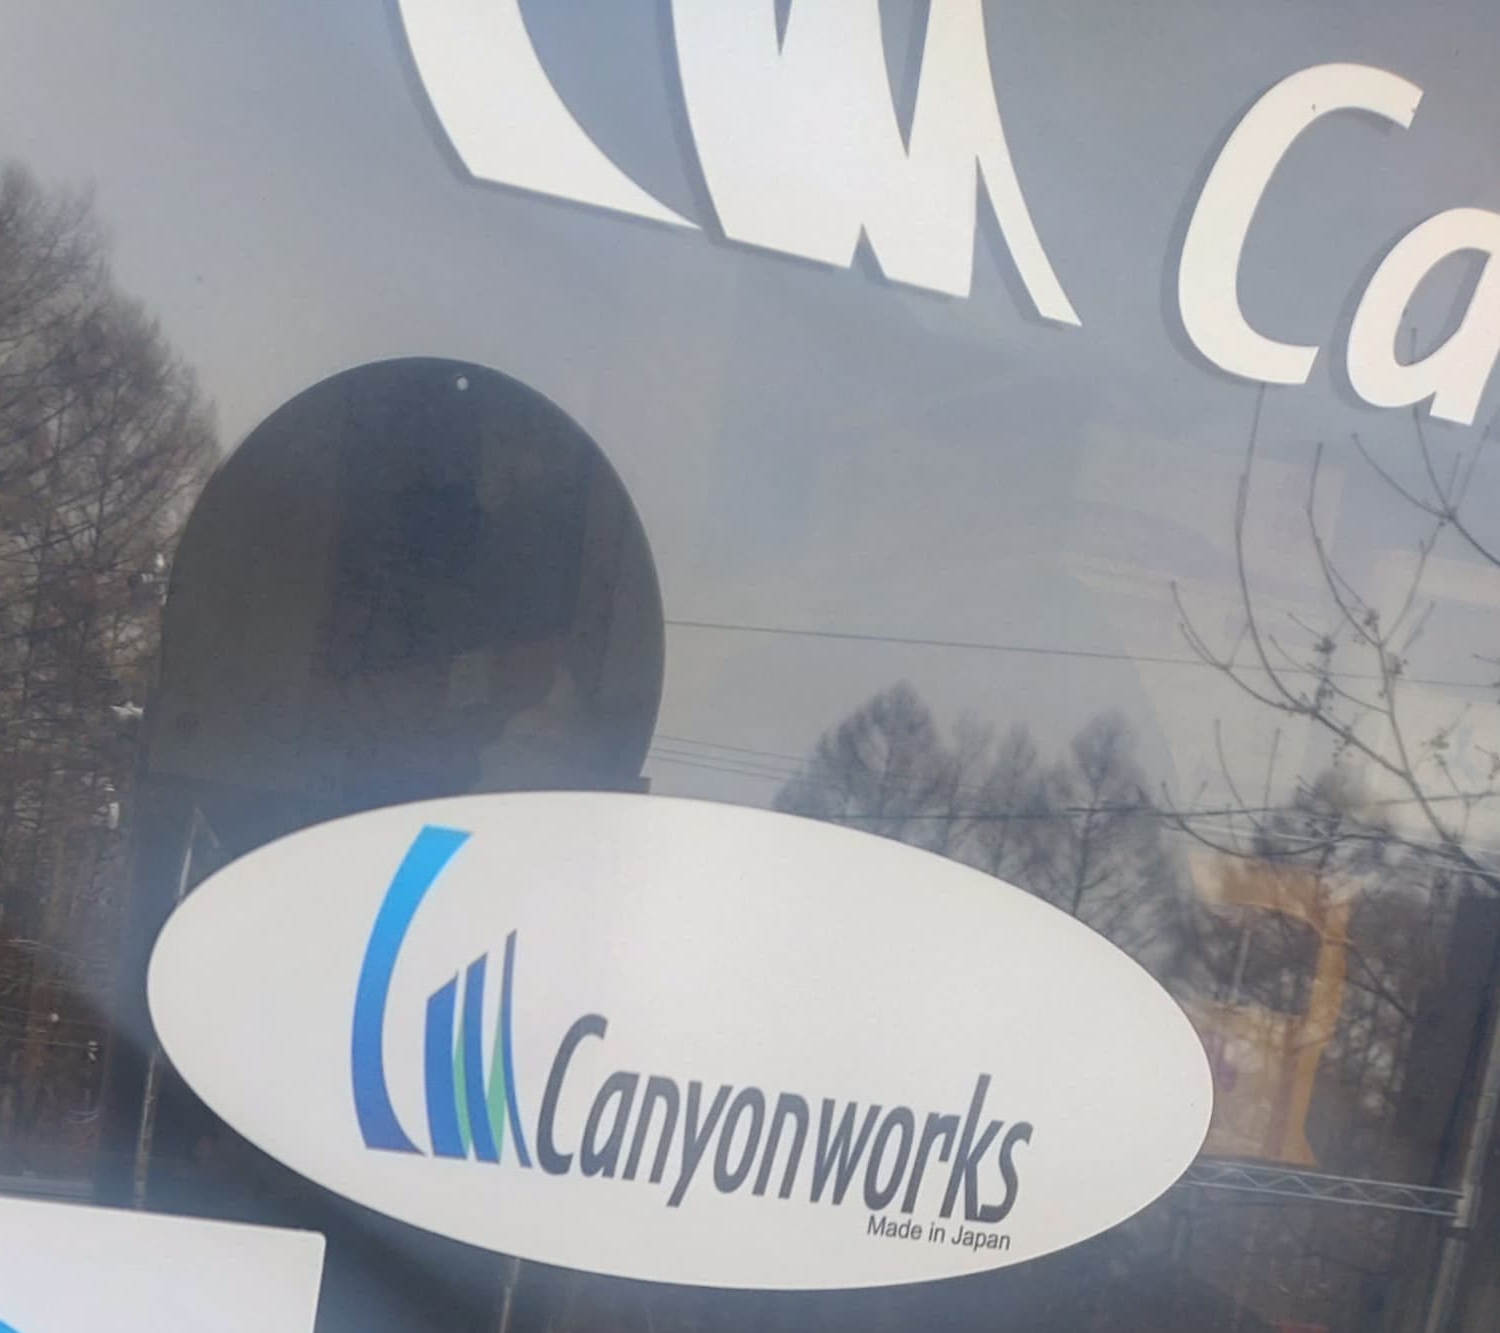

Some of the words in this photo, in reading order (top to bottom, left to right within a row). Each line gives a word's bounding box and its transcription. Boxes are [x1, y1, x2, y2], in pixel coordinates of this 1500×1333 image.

[535, 1012, 1034, 1224] Canyonworks
[866, 1214, 923, 1241] Made
[928, 1221, 946, 1244] in
[951, 1225, 1011, 1252] Japan
